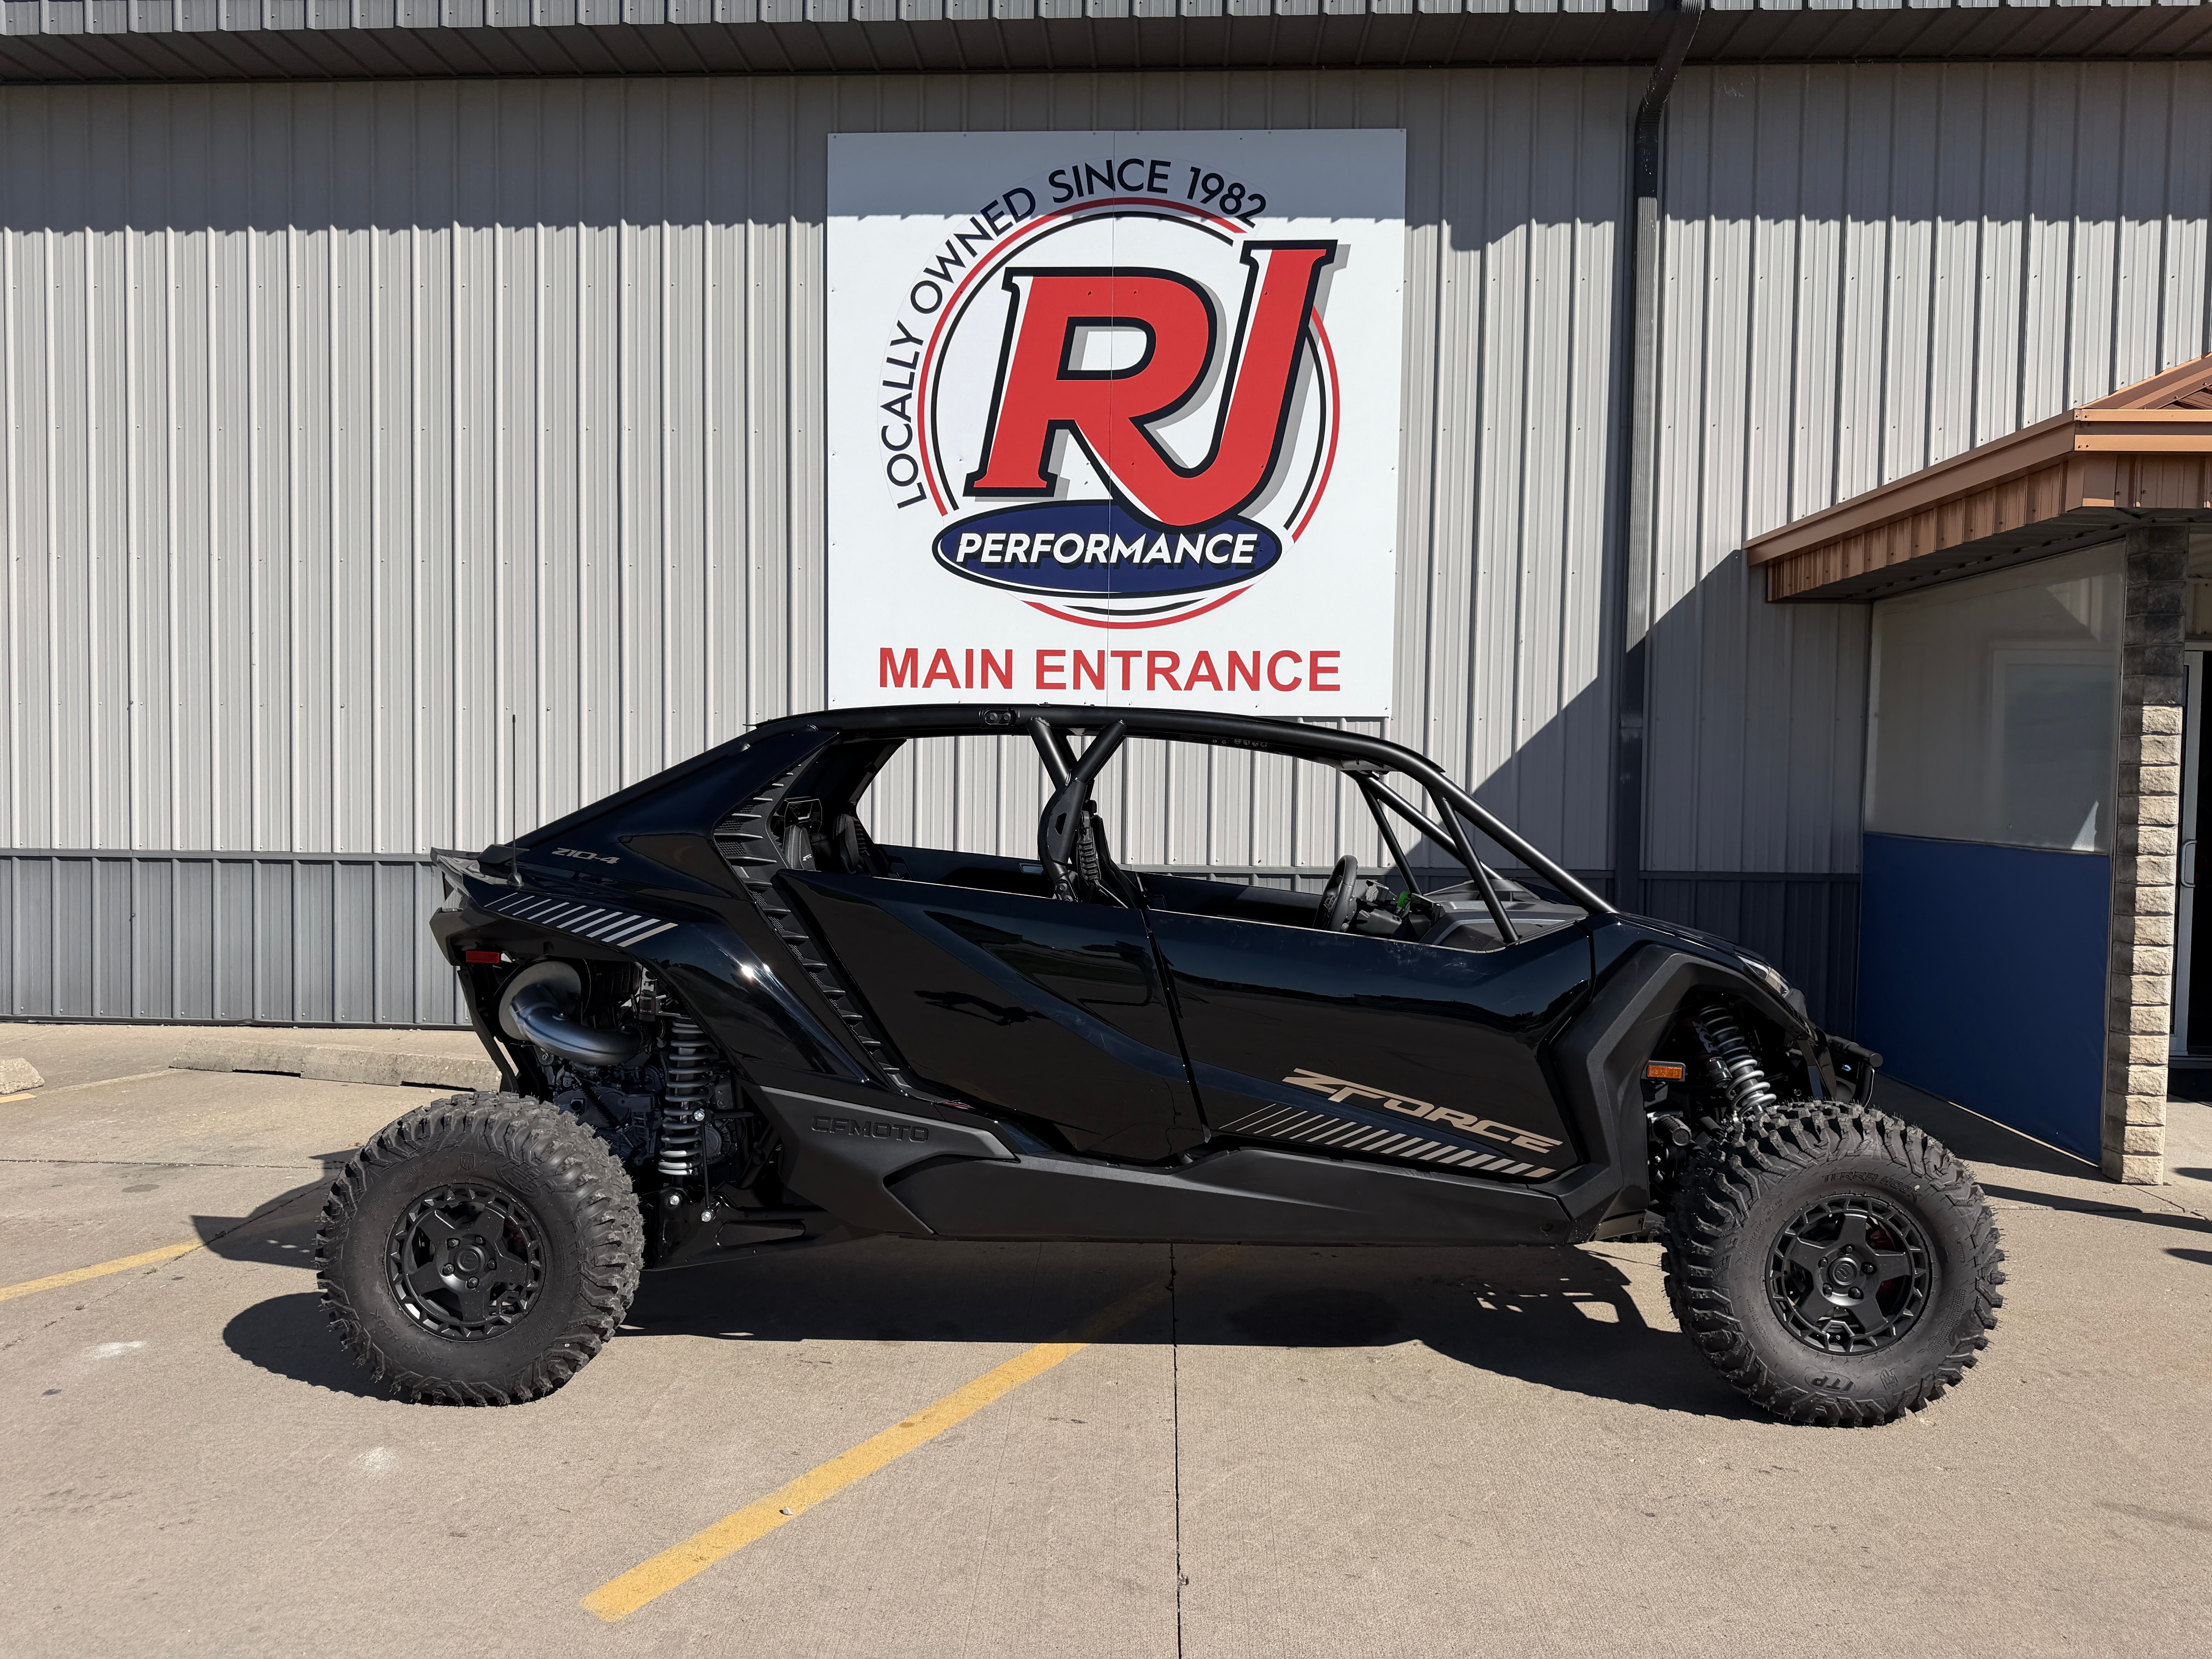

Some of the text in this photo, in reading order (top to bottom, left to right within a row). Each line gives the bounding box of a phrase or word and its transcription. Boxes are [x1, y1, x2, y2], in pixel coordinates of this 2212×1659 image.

[880, 158, 1266, 509] LOCALLY OWNED SINCE 1982
[962, 240, 1338, 533] RJ
[956, 532, 1258, 564] PERFORMANCE
[879, 647, 1341, 692] MAIN ENTRANCE
[811, 1116, 929, 1143] CFMOTO
[1282, 1068, 1563, 1154] ZFORCE
[1822, 1171, 1922, 1202] TERRA HOOK
[1811, 1376, 1854, 1393] ITP
